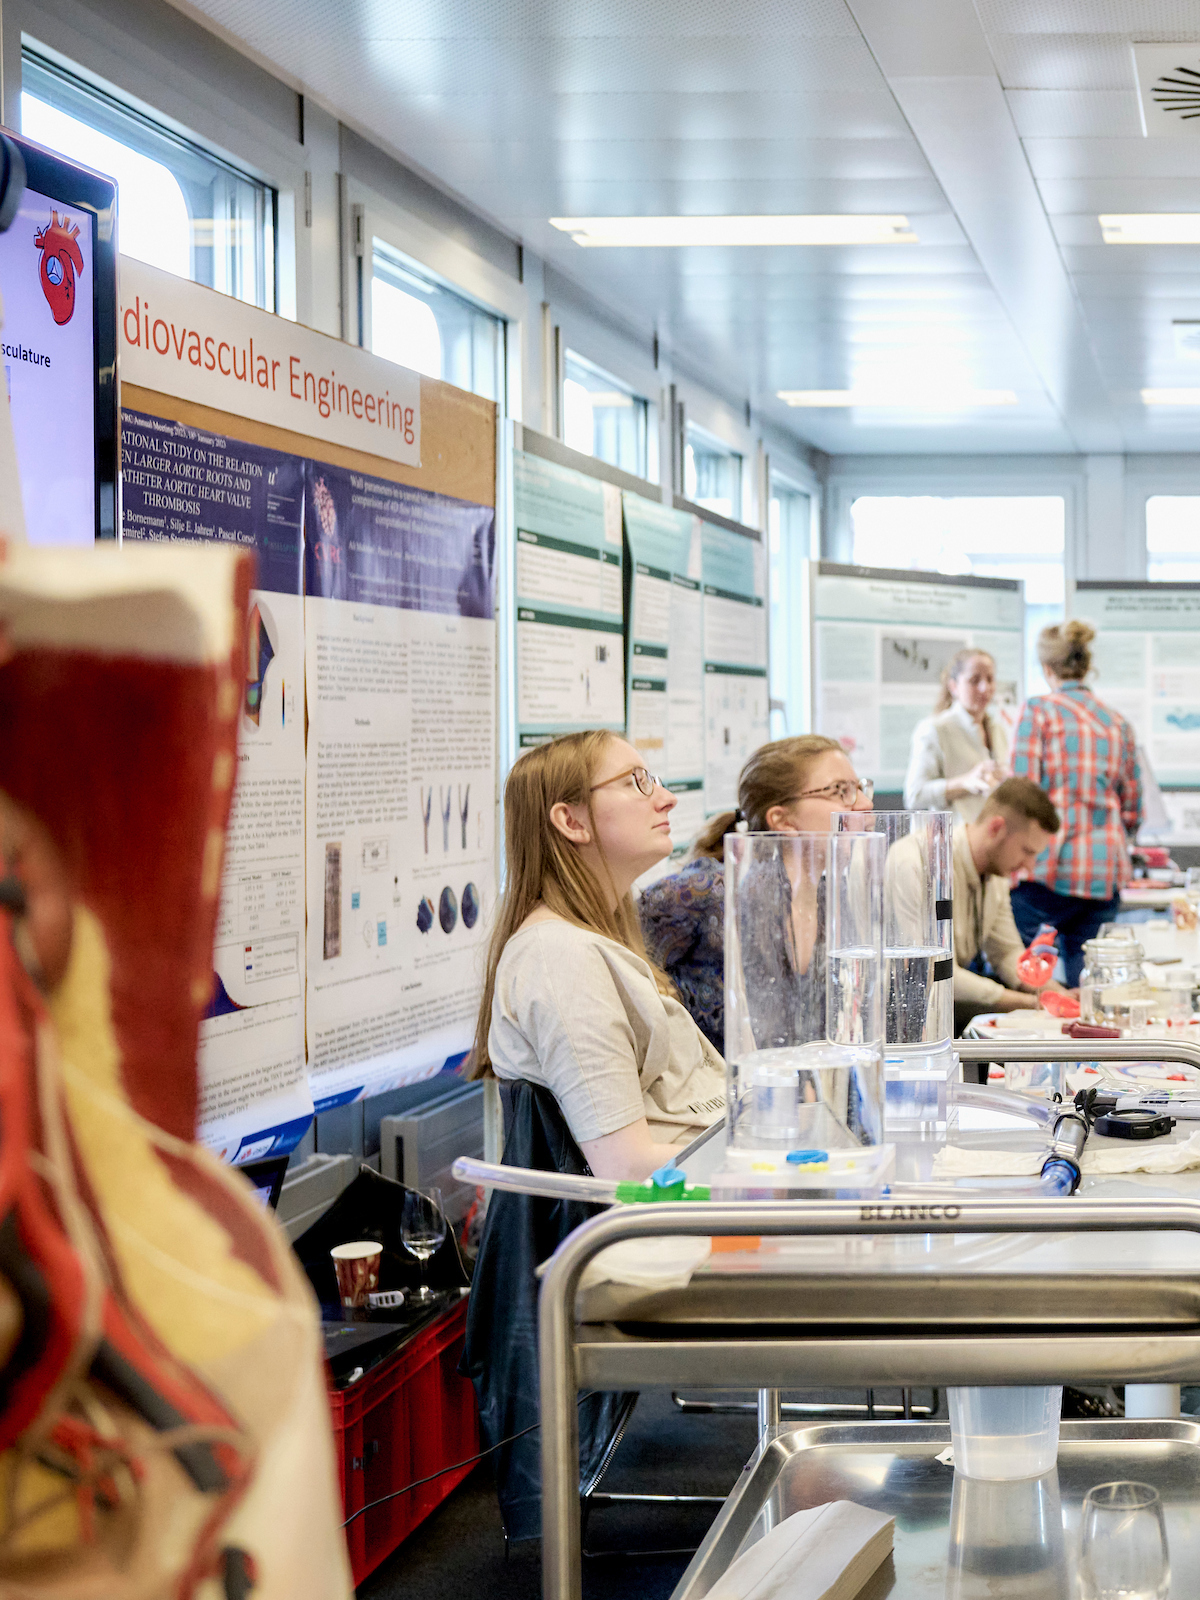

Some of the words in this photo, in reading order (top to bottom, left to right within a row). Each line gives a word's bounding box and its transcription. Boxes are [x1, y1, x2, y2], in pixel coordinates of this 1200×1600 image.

[1, 343, 51, 368] sculature
[121, 296, 280, 391] diovascular
[289, 355, 415, 445] Engineering
[134, 451, 171, 474] LARGER
[172, 462, 205, 480] AORTIC
[206, 469, 233, 487] ROOTS
[233, 476, 251, 492] AND
[163, 440, 193, 460] STUDY
[194, 448, 206, 463] ON
[207, 451, 224, 468] THE
[225, 457, 263, 477] RELATION
[142, 491, 201, 515] THROMBOSIS
[164, 479, 198, 497] AORTIC
[198, 485, 225, 503] HEART
[226, 491, 252, 509] VALVE
[860, 1204, 961, 1221] BLANCO
